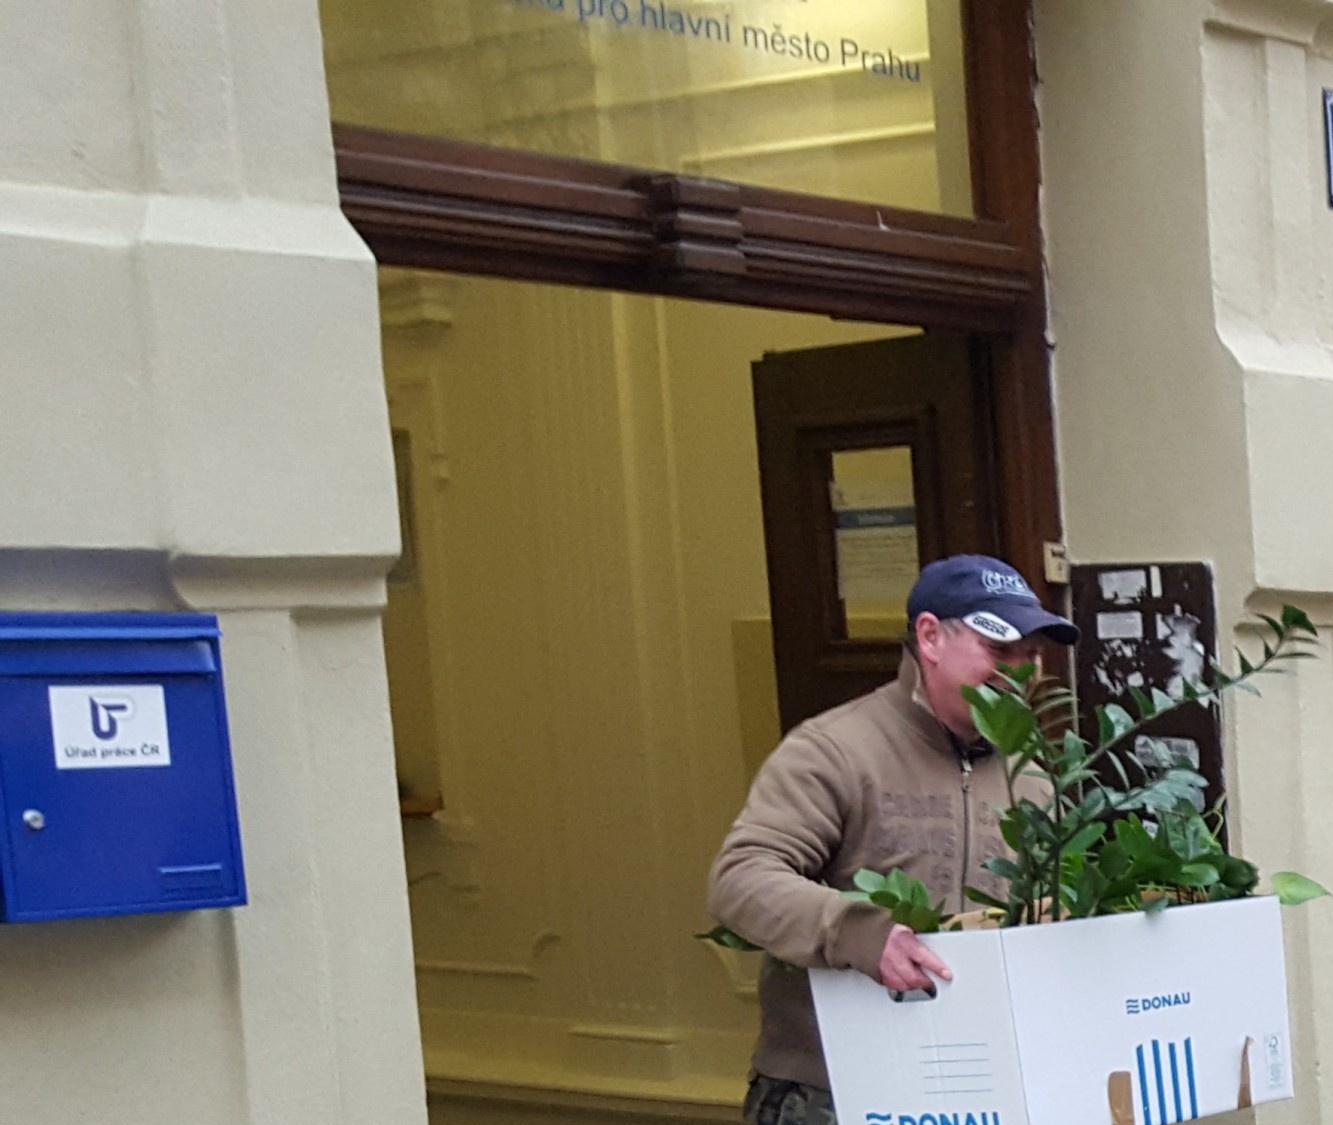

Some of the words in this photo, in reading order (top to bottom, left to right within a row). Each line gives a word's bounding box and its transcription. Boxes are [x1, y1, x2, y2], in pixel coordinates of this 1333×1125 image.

[743, 24, 830, 63] město
[840, 38, 921, 82] Prahu
[65, 745, 97, 758] Úřad
[101, 746, 137, 759] práce
[141, 743, 160, 756] ČR
[1141, 992, 1192, 1011] DONAU
